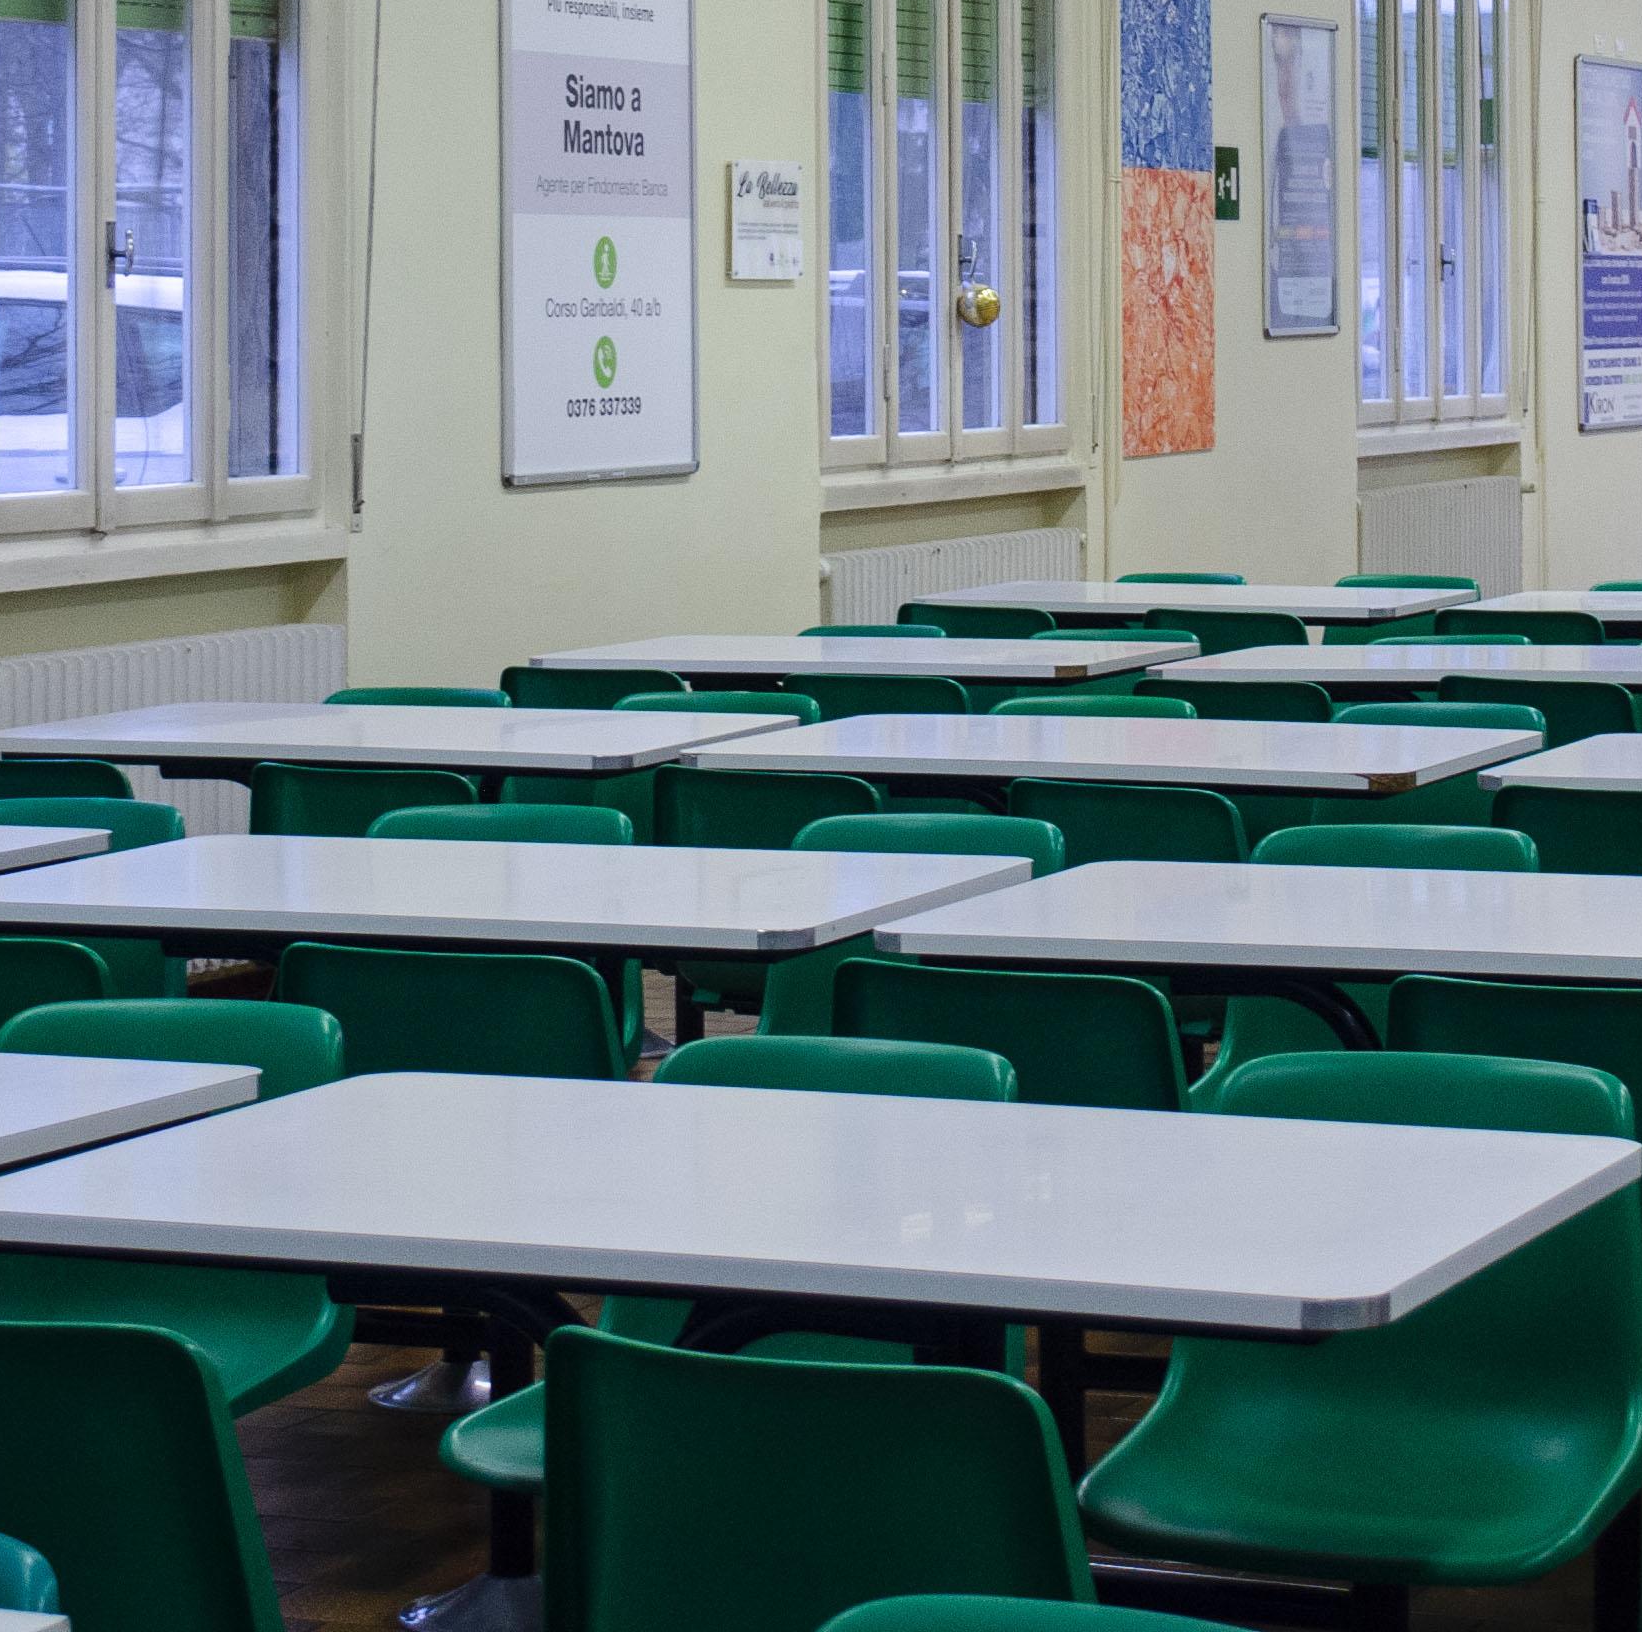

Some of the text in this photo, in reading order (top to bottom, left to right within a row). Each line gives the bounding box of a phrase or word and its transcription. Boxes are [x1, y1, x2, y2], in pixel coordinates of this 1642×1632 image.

[622, 2, 654, 23] insieme
[565, 73, 641, 112] Siamo a
[563, 119, 645, 156] Mantova
[536, 174, 668, 198] Agente per Findomestic Banca
[737, 170, 798, 200] La Bellezza
[545, 297, 577, 318] Corso
[580, 297, 628, 319] Garibaldi,
[630, 298, 643, 317] 40
[566, 396, 642, 418] 0376 337339
